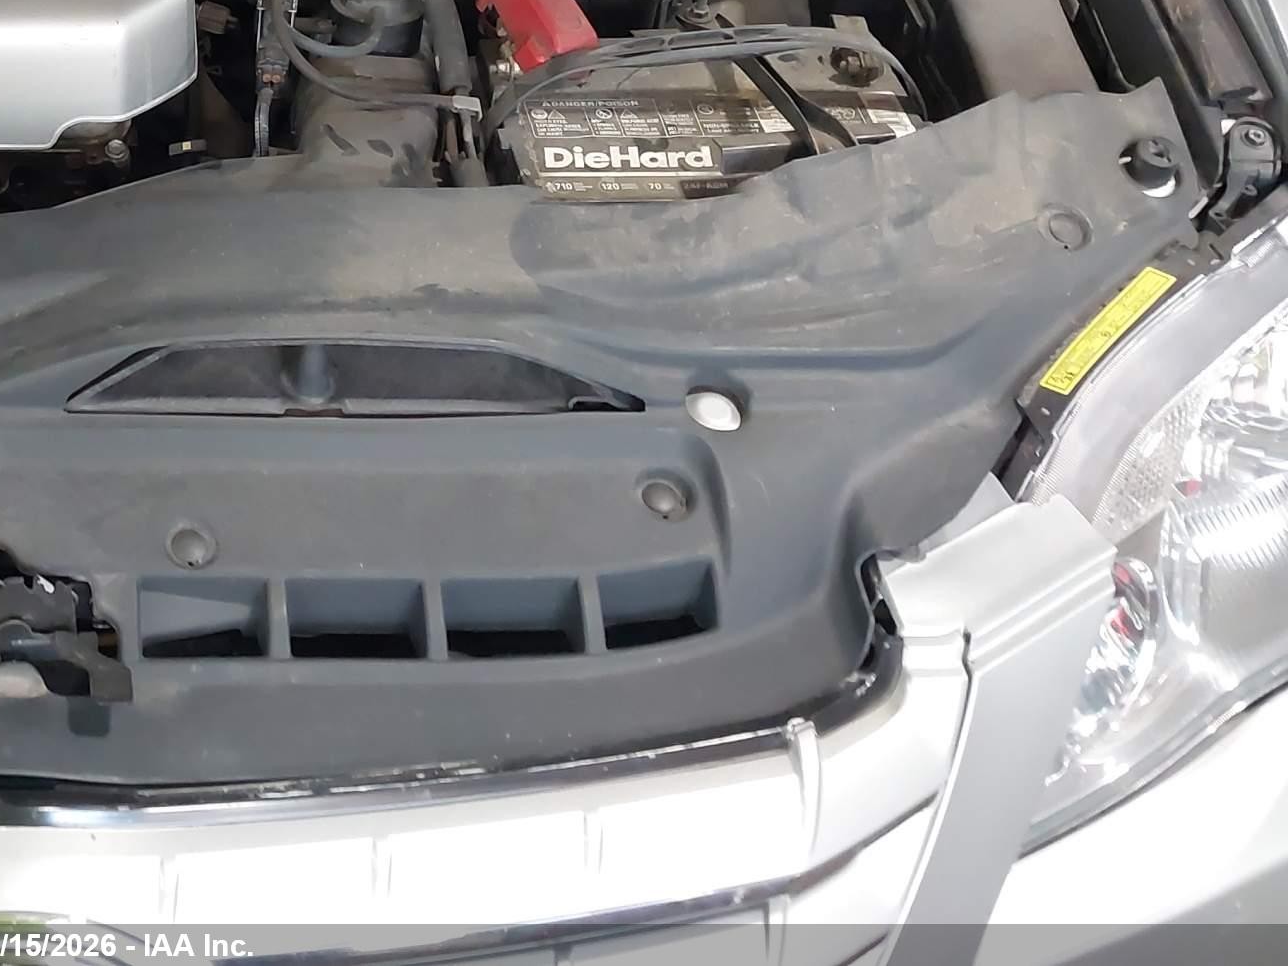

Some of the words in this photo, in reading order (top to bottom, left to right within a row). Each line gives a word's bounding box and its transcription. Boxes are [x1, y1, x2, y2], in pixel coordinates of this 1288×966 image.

[543, 146, 714, 169] DieHard
[554, 182, 573, 191] 710
[601, 182, 620, 191] 120
[648, 182, 662, 191] 70
